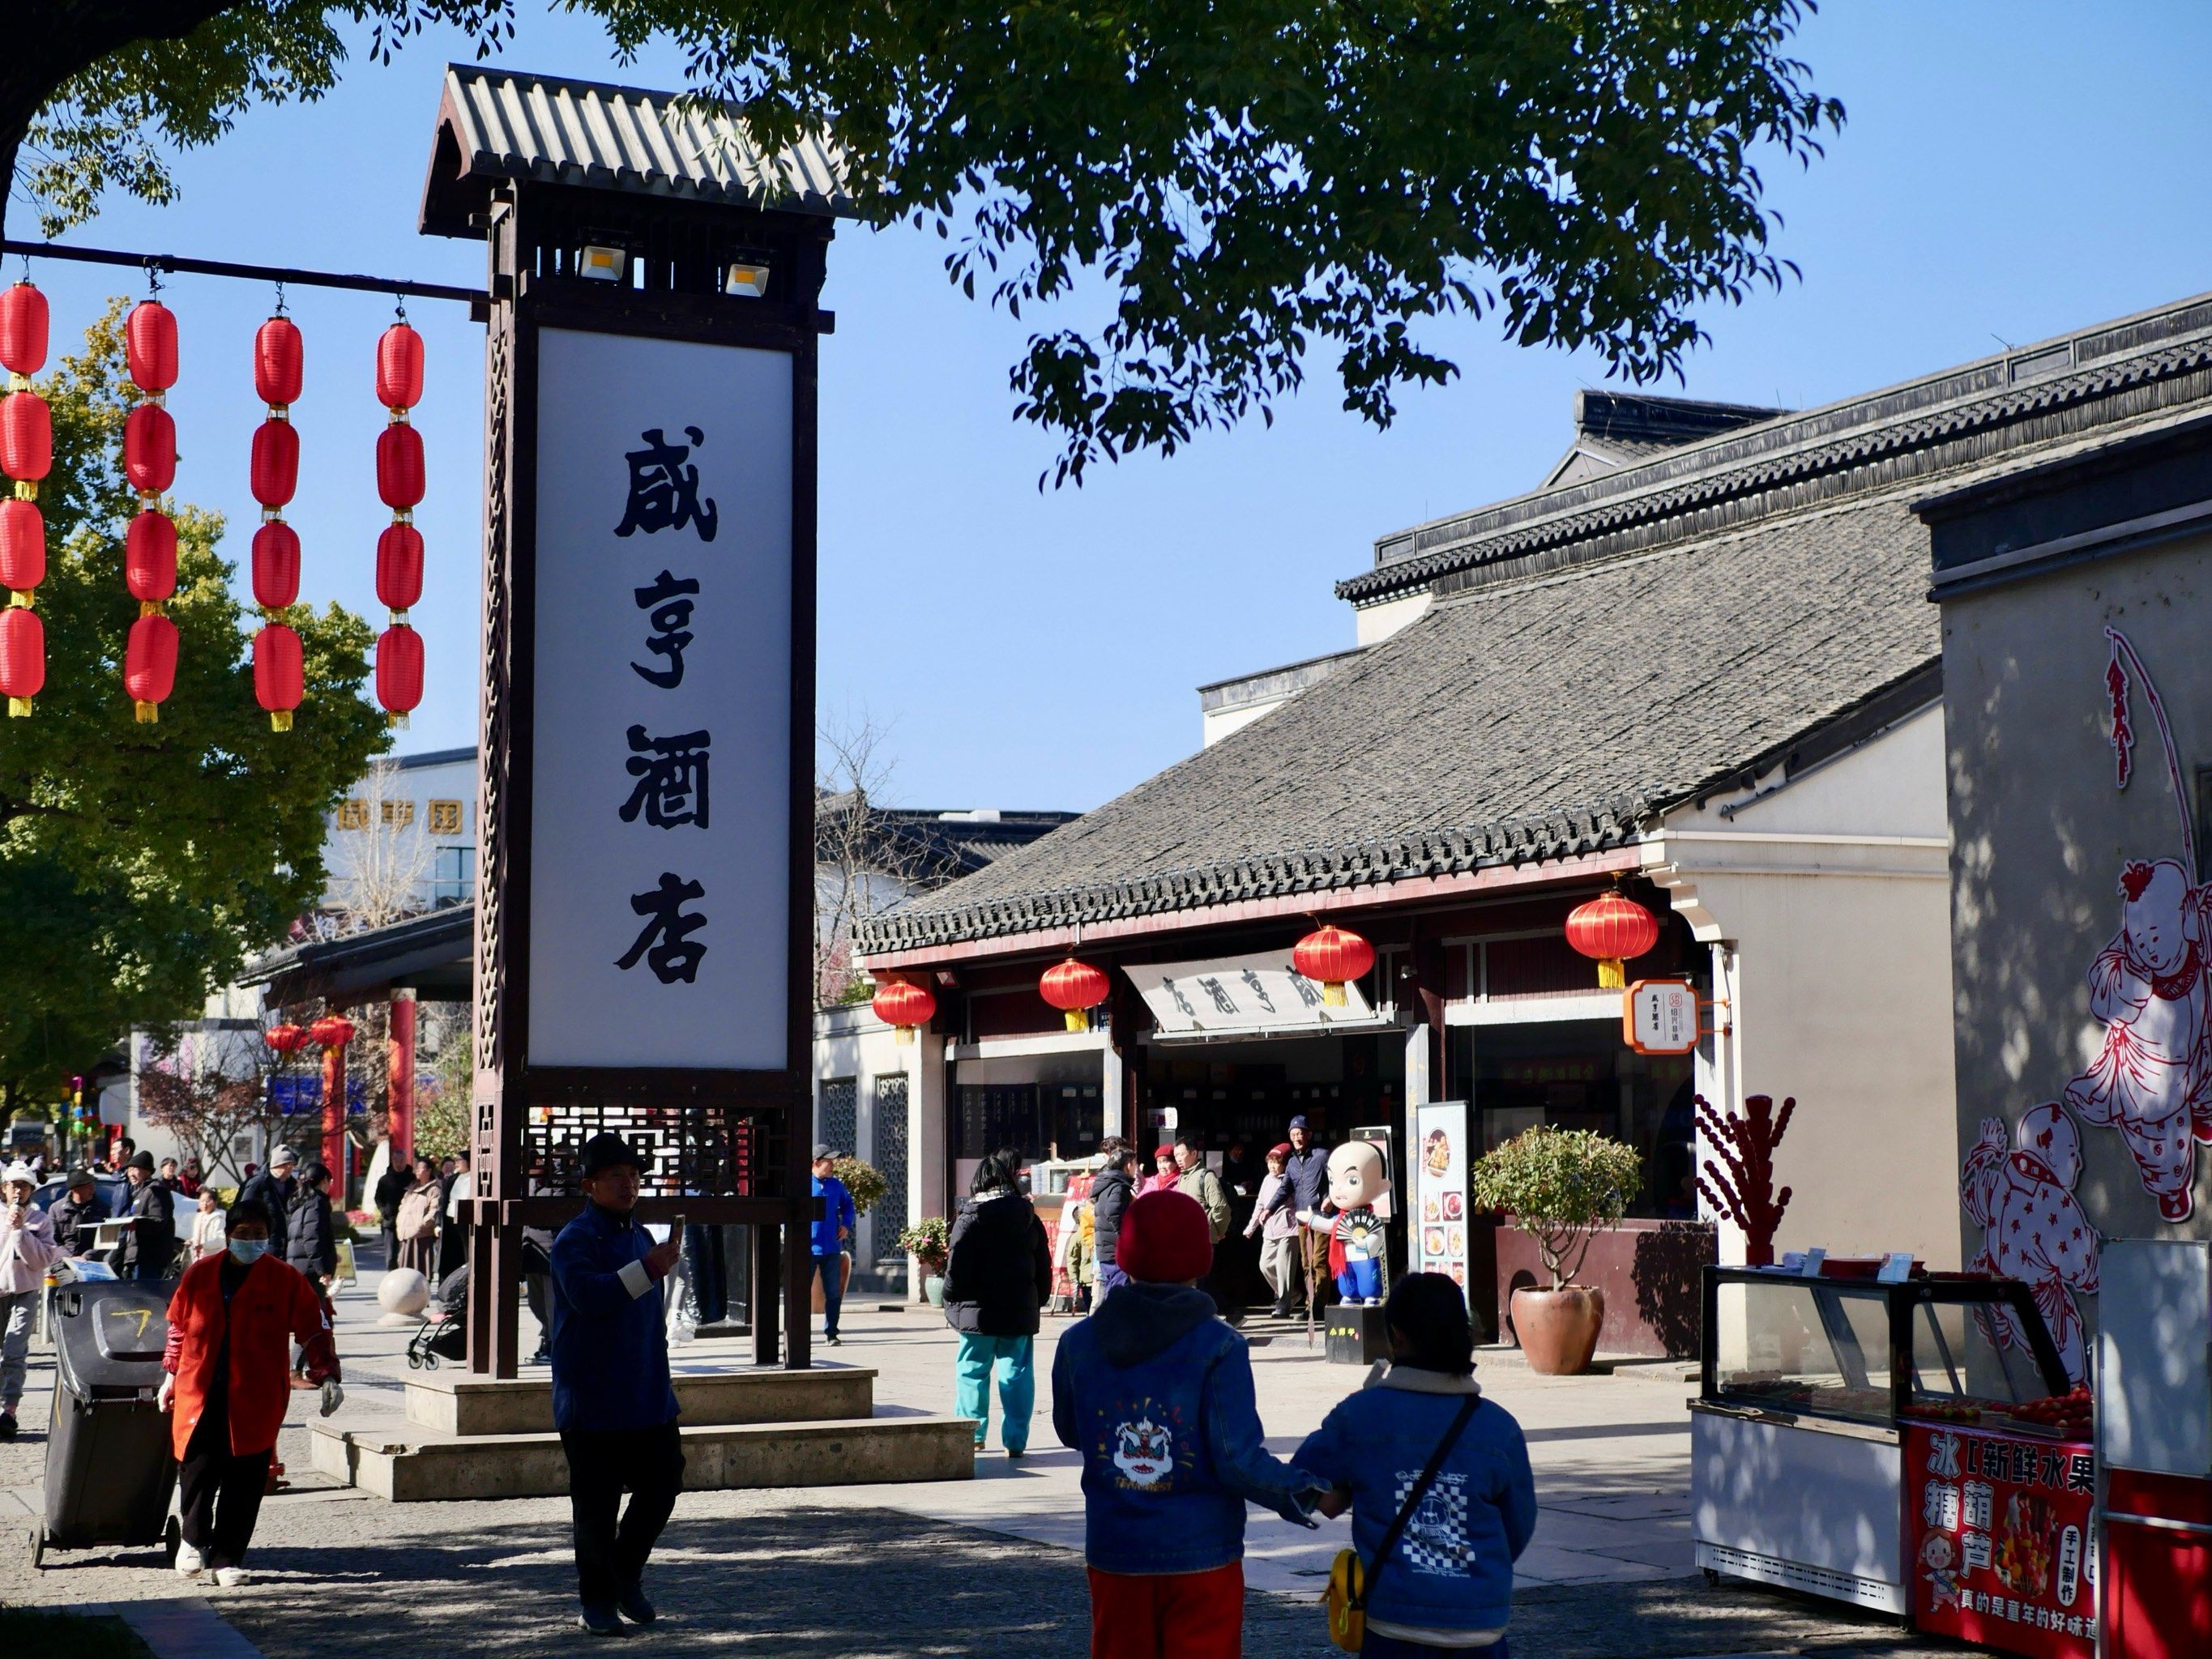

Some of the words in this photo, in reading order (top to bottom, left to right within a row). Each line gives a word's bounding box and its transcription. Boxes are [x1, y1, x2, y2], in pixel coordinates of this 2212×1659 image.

[613, 425, 719, 985] 咸亨酒店
[2060, 1529, 2078, 1602] 手工制作
[1960, 1587, 2097, 1640] 真的是童年的好味道
